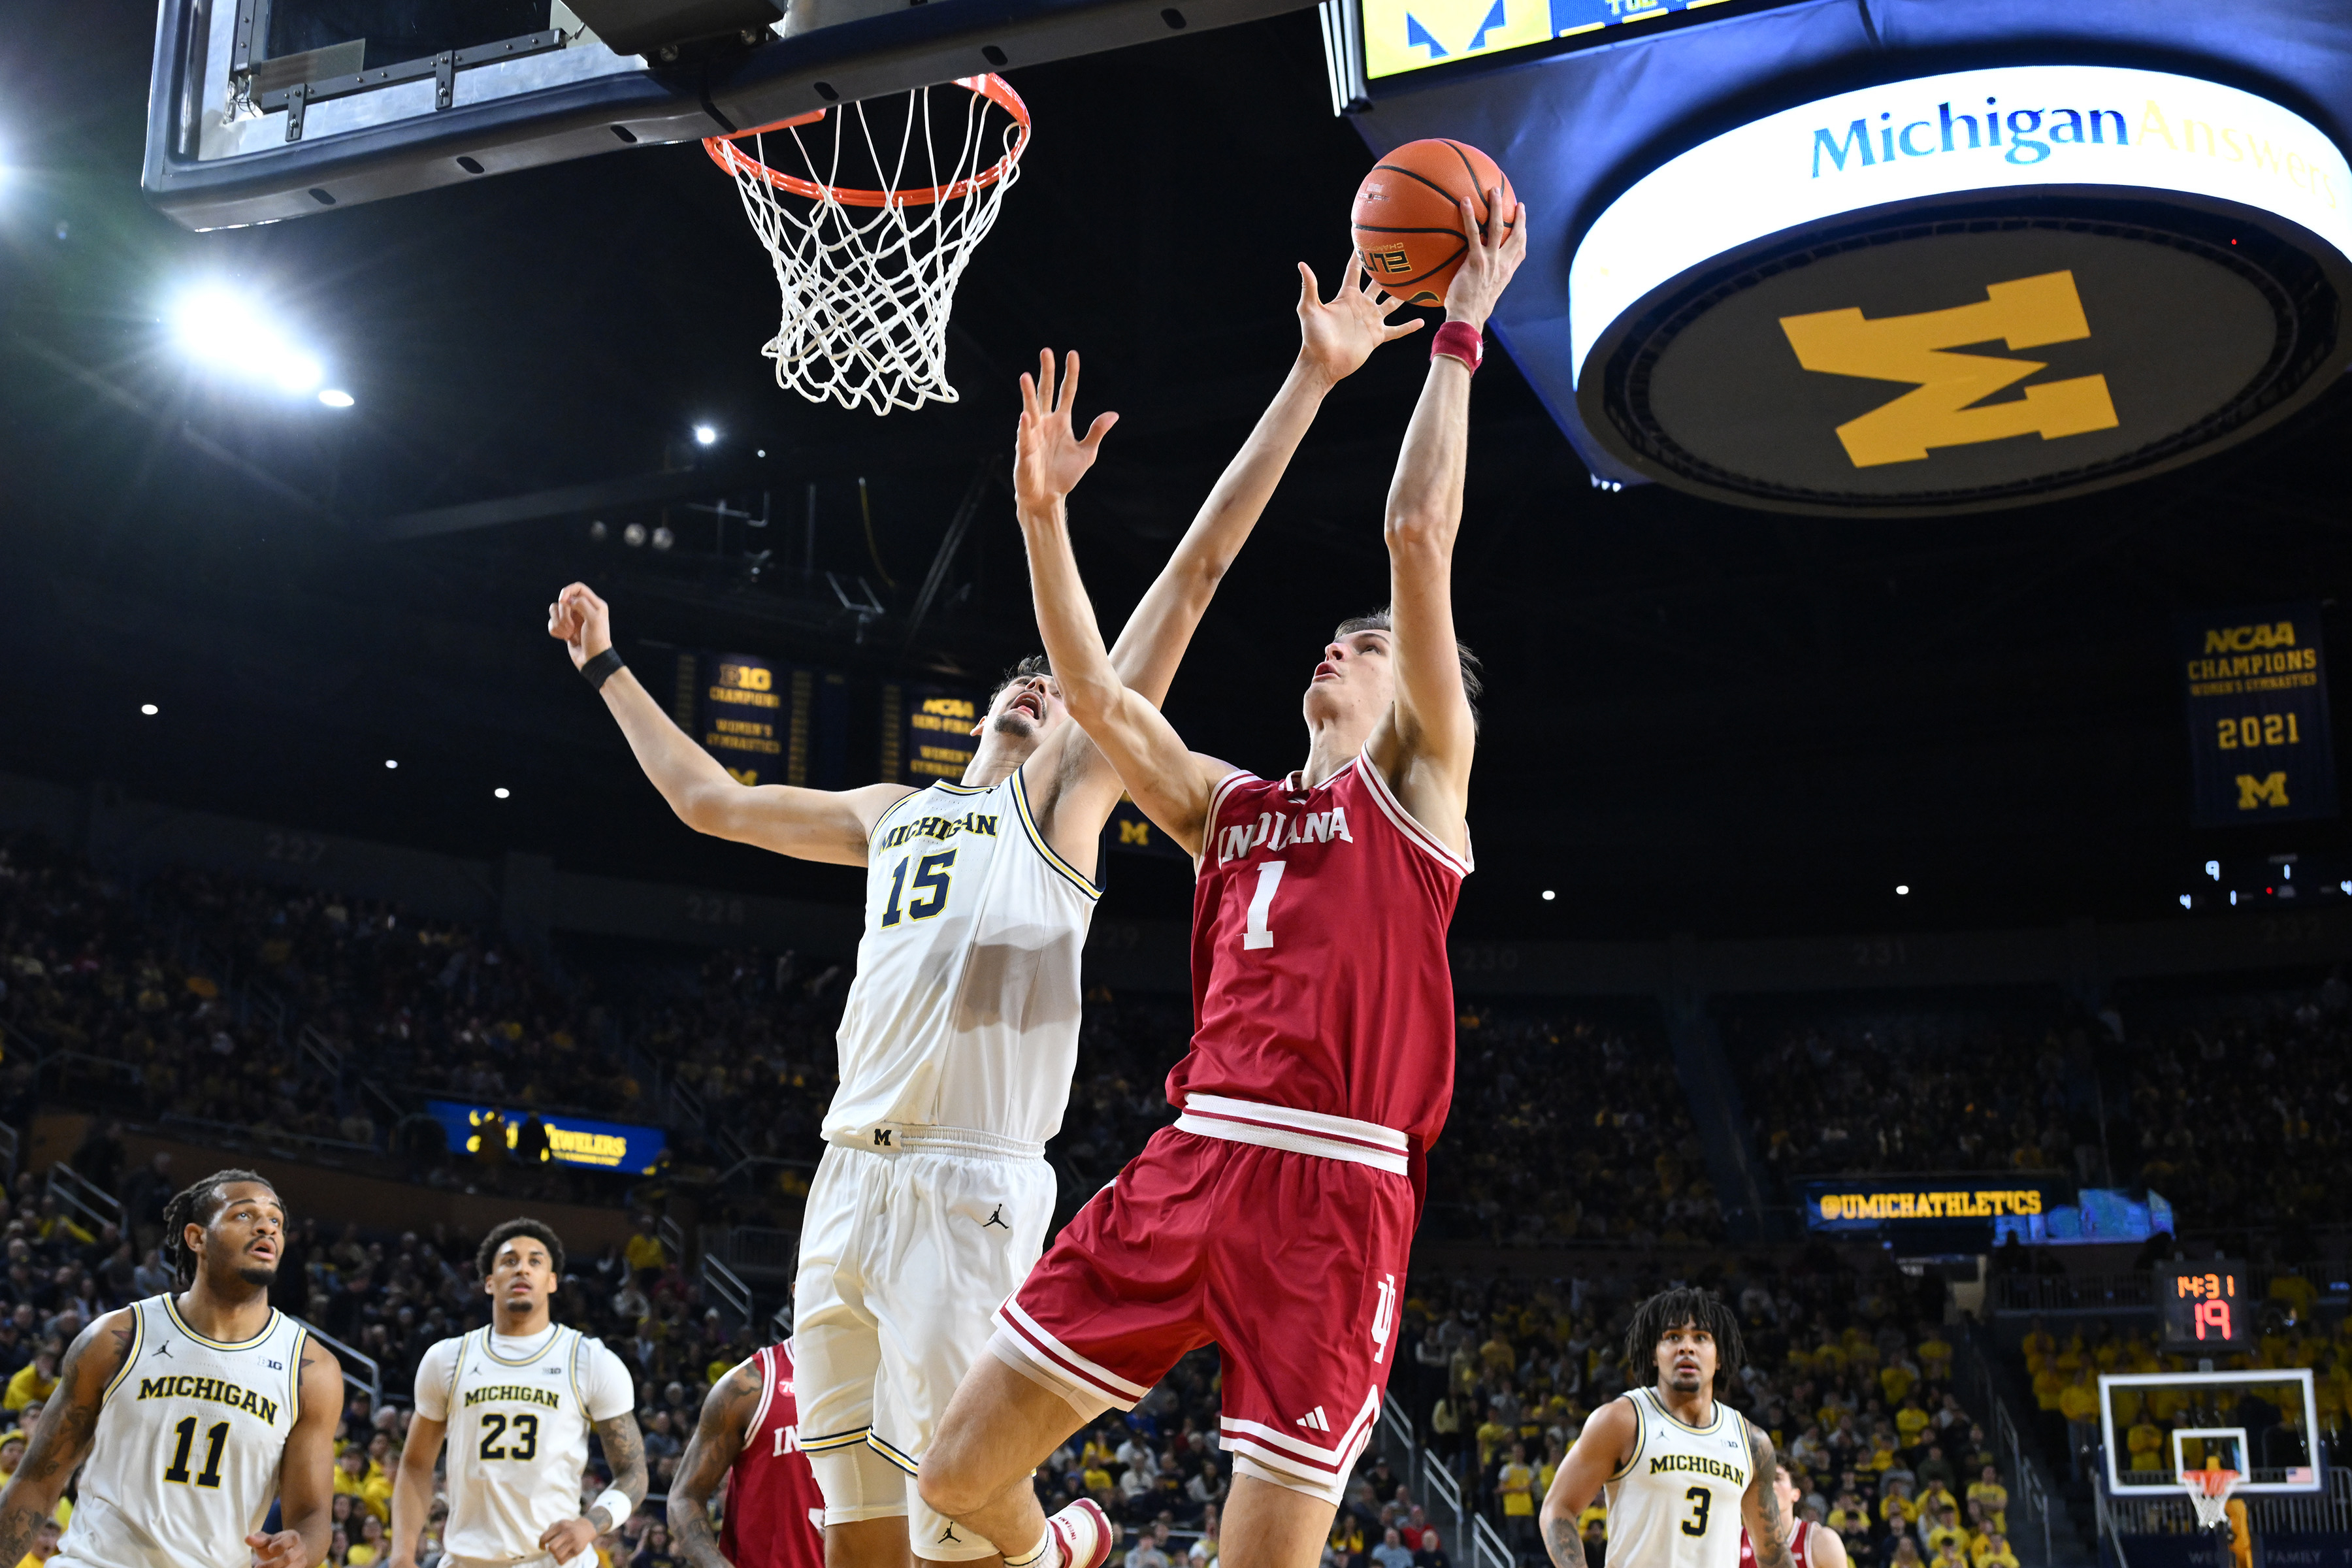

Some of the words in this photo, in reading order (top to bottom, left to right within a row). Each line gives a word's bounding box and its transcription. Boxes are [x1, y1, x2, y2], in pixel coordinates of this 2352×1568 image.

[1811, 97, 2129, 178] Michigan
[2205, 621, 2296, 654] NCAA
[2188, 648, 2317, 679] CHAMPIONS
[2217, 713, 2300, 750] 2021
[2234, 771, 2289, 810] M
[878, 811, 998, 857] MICHIGAN
[1119, 819, 1149, 845] M
[1218, 807, 1353, 870] INDIANA
[881, 847, 958, 930] 15
[1243, 860, 1286, 950] 1
[874, 1128, 892, 1146] M
[1820, 1190, 2042, 1220] @UMICHATHLETICS
[2178, 1273, 2234, 1299] 14:31
[2195, 1299, 2232, 1340] 19
[137, 1376, 278, 1427] MICHIGAN
[465, 1385, 559, 1409] MICHIGAN
[163, 1415, 231, 1489] 11
[480, 1413, 538, 1461] 23
[1650, 1454, 1744, 1488] MICHIGAN
[1681, 1486, 1712, 1537] 3
